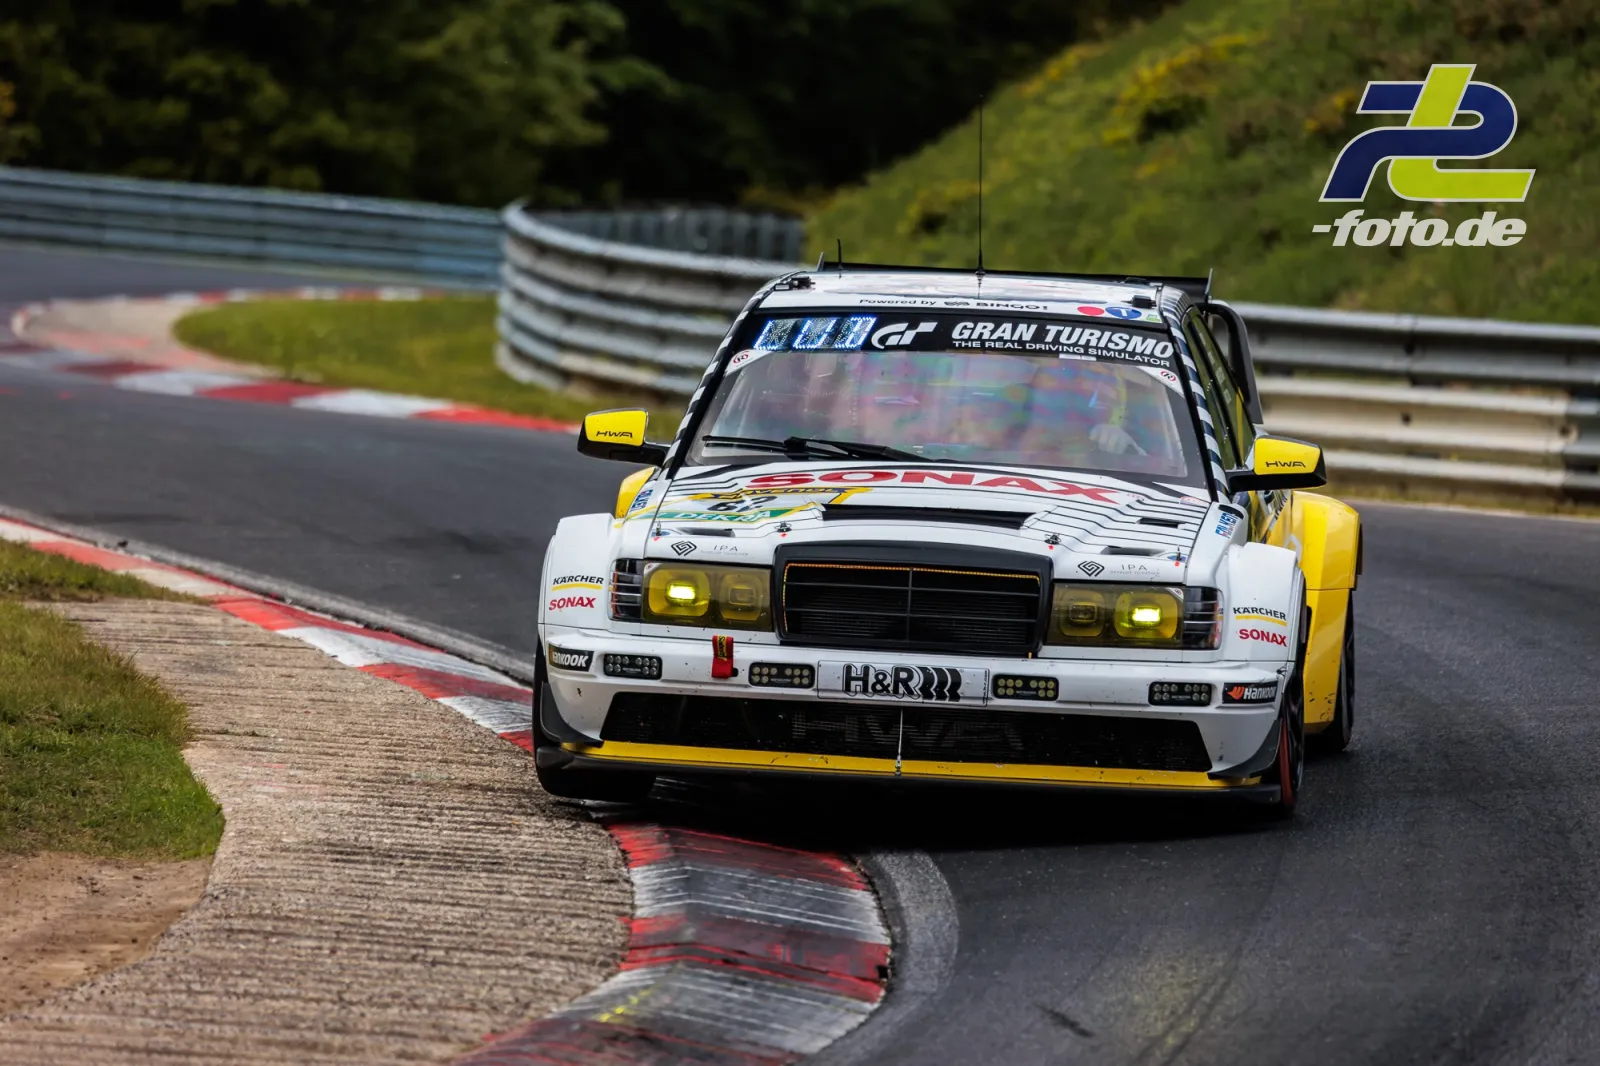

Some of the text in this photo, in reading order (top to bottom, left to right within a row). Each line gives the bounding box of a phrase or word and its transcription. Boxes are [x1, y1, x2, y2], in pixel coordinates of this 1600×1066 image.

[951, 321, 1174, 358] GRAN TURISMO
[952, 340, 1171, 367] THE REAL DRIVING SIMULATOR
[595, 430, 633, 438] HWA
[1265, 460, 1306, 468] HWA
[746, 470, 1120, 505] SONAX
[673, 510, 771, 523] DEKRA
[713, 544, 738, 552] IPA
[1121, 563, 1148, 571] IPA
[553, 574, 604, 585] KÄRCHER
[549, 596, 596, 611] SONAX
[1239, 628, 1288, 647] SONAX
[842, 663, 921, 700] H&R
